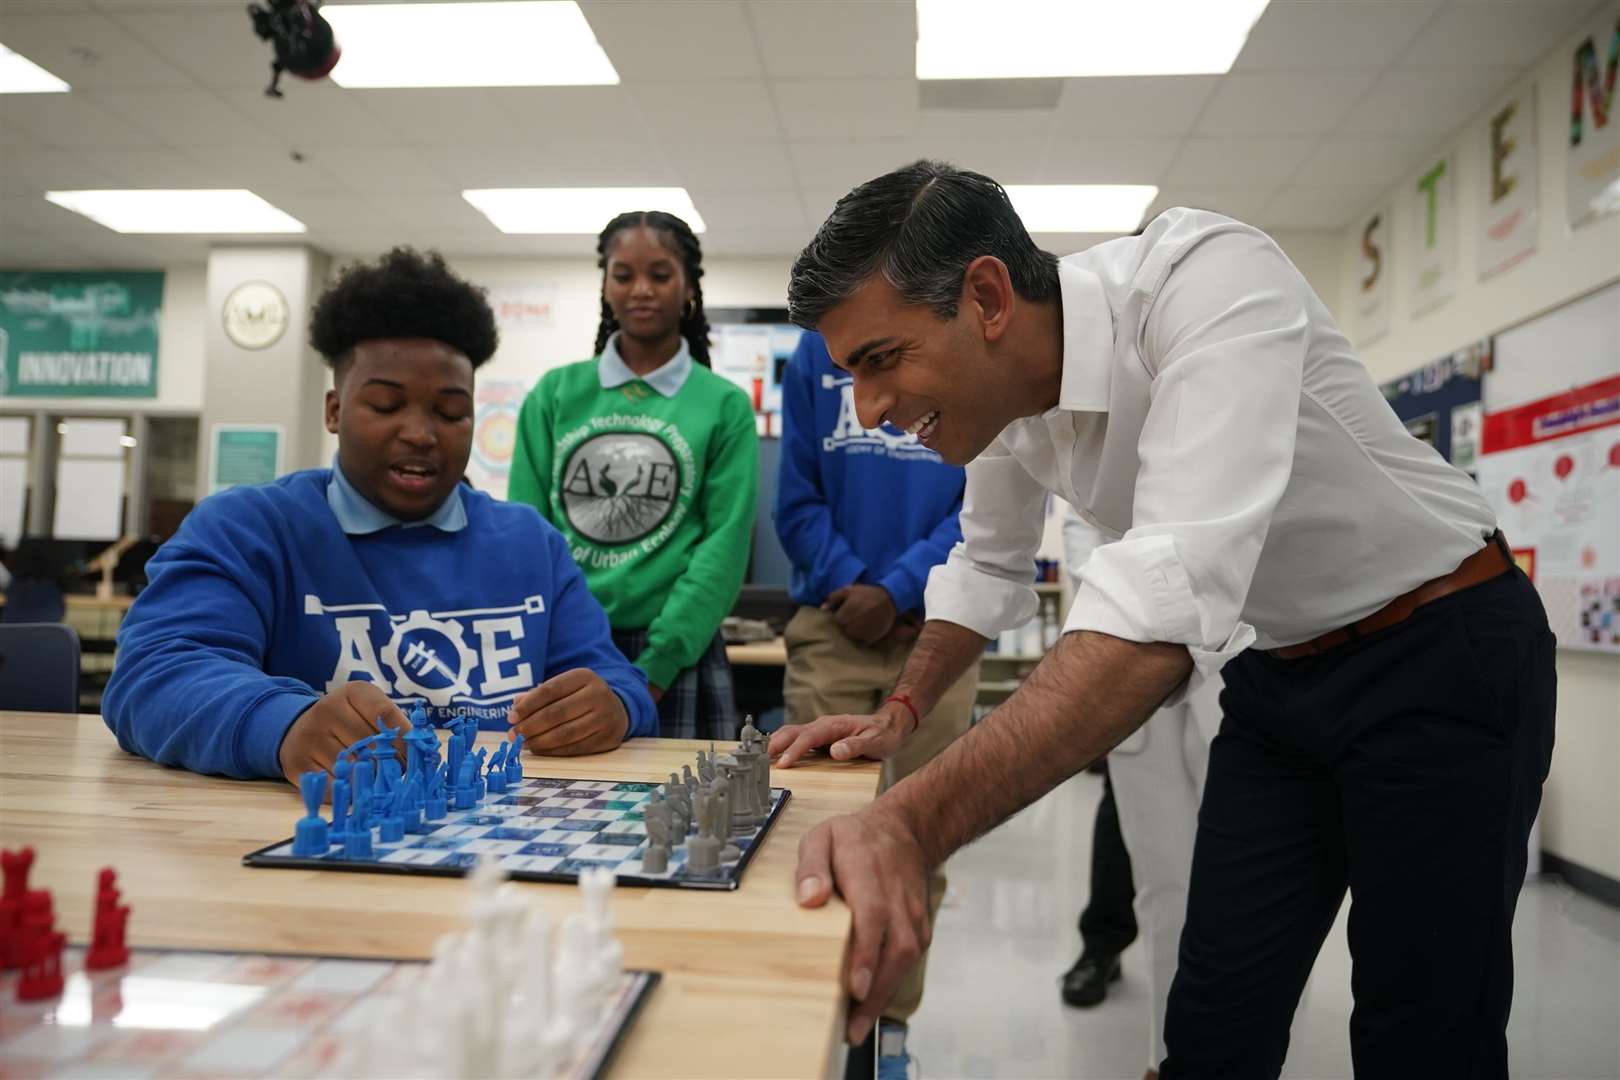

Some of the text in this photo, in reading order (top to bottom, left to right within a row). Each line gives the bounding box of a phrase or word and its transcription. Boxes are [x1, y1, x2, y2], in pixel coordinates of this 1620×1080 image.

[18, 351, 152, 386] INNOVATION
[591, 413, 665, 431] Technology
[573, 547, 590, 561] of
[591, 548, 640, 568] Urban
[438, 704, 512, 720] ENGINEERIN
